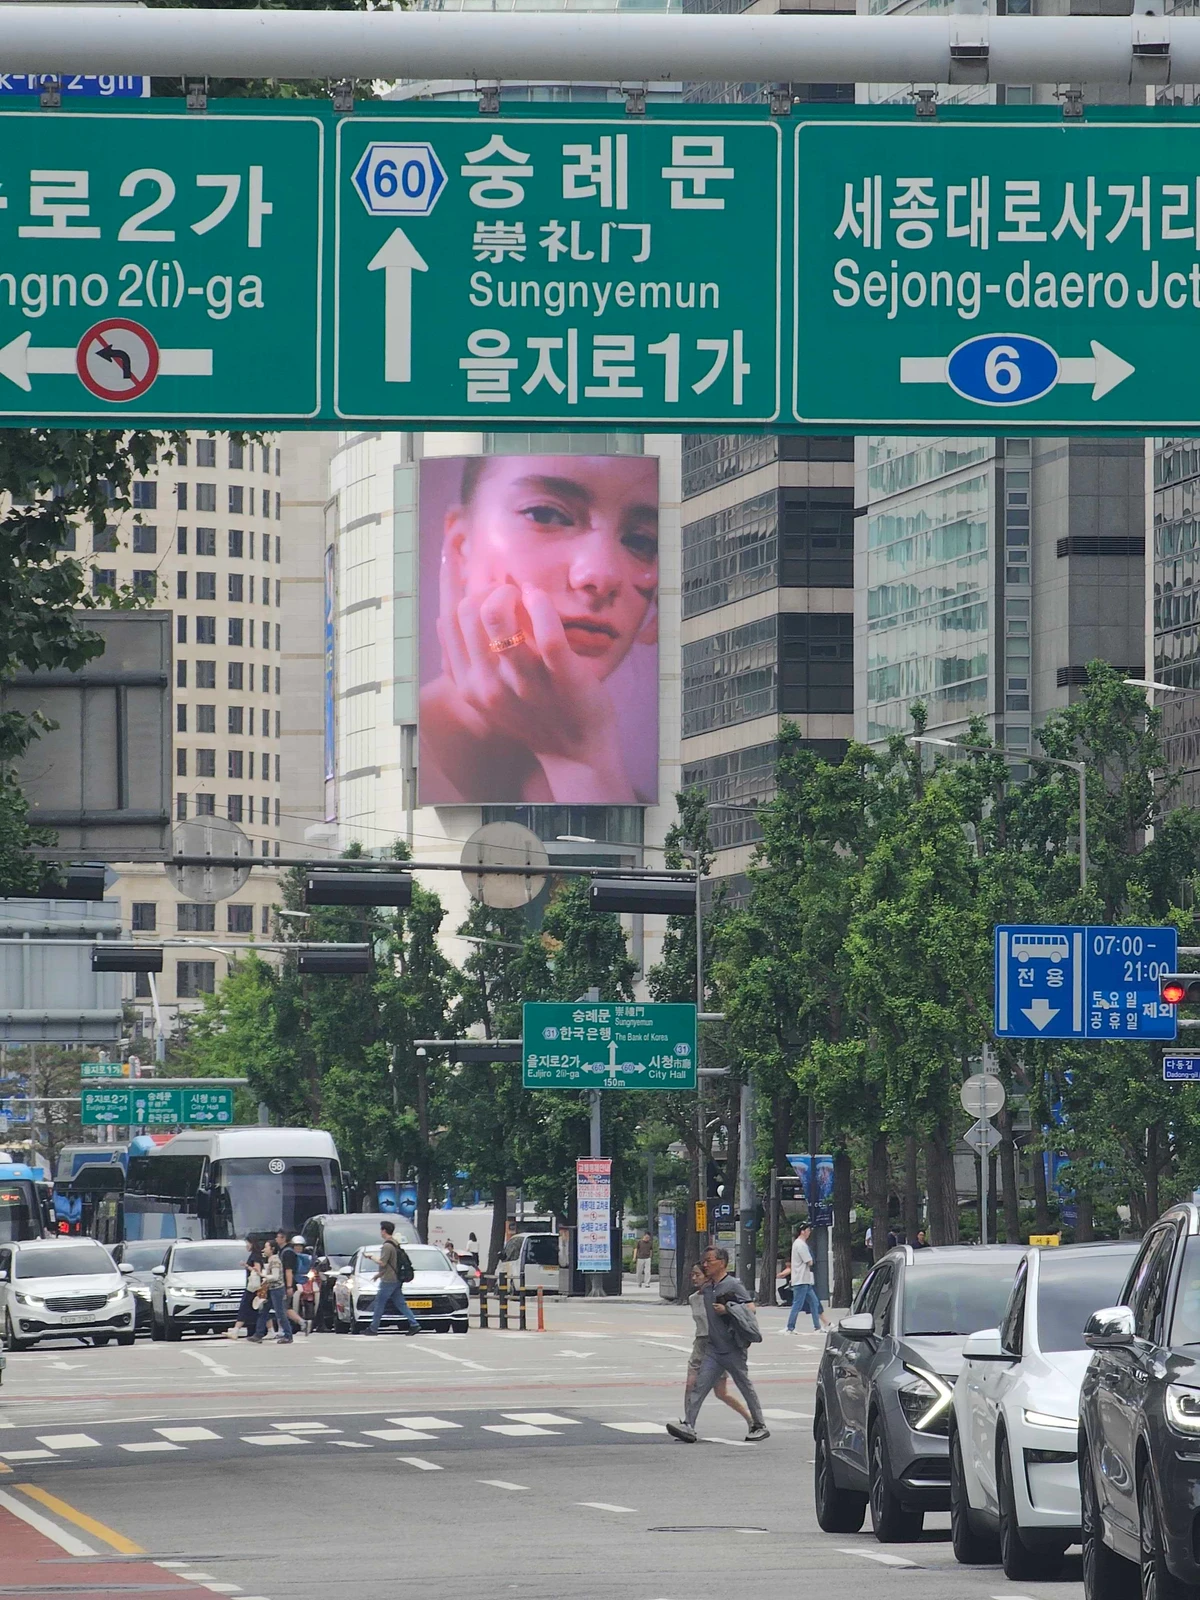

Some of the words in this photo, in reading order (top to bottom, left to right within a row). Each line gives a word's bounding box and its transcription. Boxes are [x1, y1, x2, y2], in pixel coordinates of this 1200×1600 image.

[373, 160, 426, 198] 60
[0, 165, 273, 248] 로2가
[833, 175, 1200, 251] 세종대로사거리
[118, 260, 265, 319] 2(i)-ga
[469, 271, 720, 316] Sungnyemun
[833, 258, 1128, 320] Sejong-daero
[459, 328, 750, 406] 을지로1가
[984, 345, 1022, 395] 6
[1017, 968, 1065, 988] 전용
[572, 1009, 611, 1023] 숭례문
[1142, 1002, 1174, 1018] 제외
[615, 1018, 653, 1028] Sungnyemun
[1090, 1011, 1138, 1030] 공휴일
[546, 1029, 555, 1037] 31
[560, 1027, 611, 1041] 한국은행
[615, 1033, 626, 1041] The
[627, 1033, 643, 1041] Bank
[643, 1033, 650, 1041] of
[651, 1033, 669, 1041] Korea
[527, 1055, 580, 1068] 을지로2가
[649, 1055, 673, 1069] 시청
[603, 1079, 625, 1087] 150m
[649, 1070, 666, 1080] City
[670, 1070, 686, 1079] Hall
[271, 1161, 283, 1171] 58
